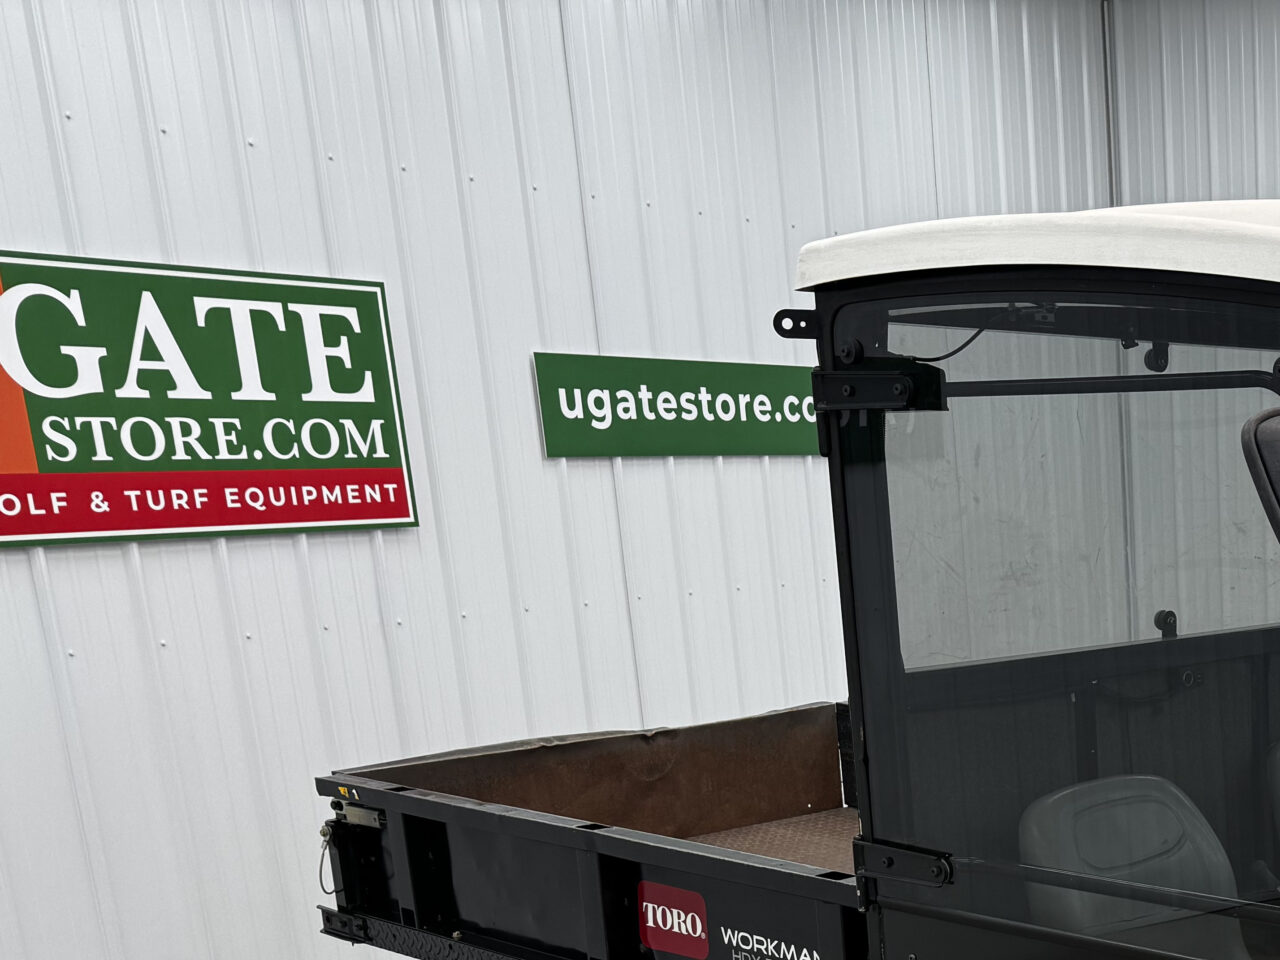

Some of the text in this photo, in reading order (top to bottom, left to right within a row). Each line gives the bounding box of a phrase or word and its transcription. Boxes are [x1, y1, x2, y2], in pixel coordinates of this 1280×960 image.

[0, 282, 376, 403] GATE
[557, 384, 817, 430] ugatestore.co
[41, 415, 390, 462] STORE.COM
[0, 483, 398, 516] OLF & TURF EQUIPMENT
